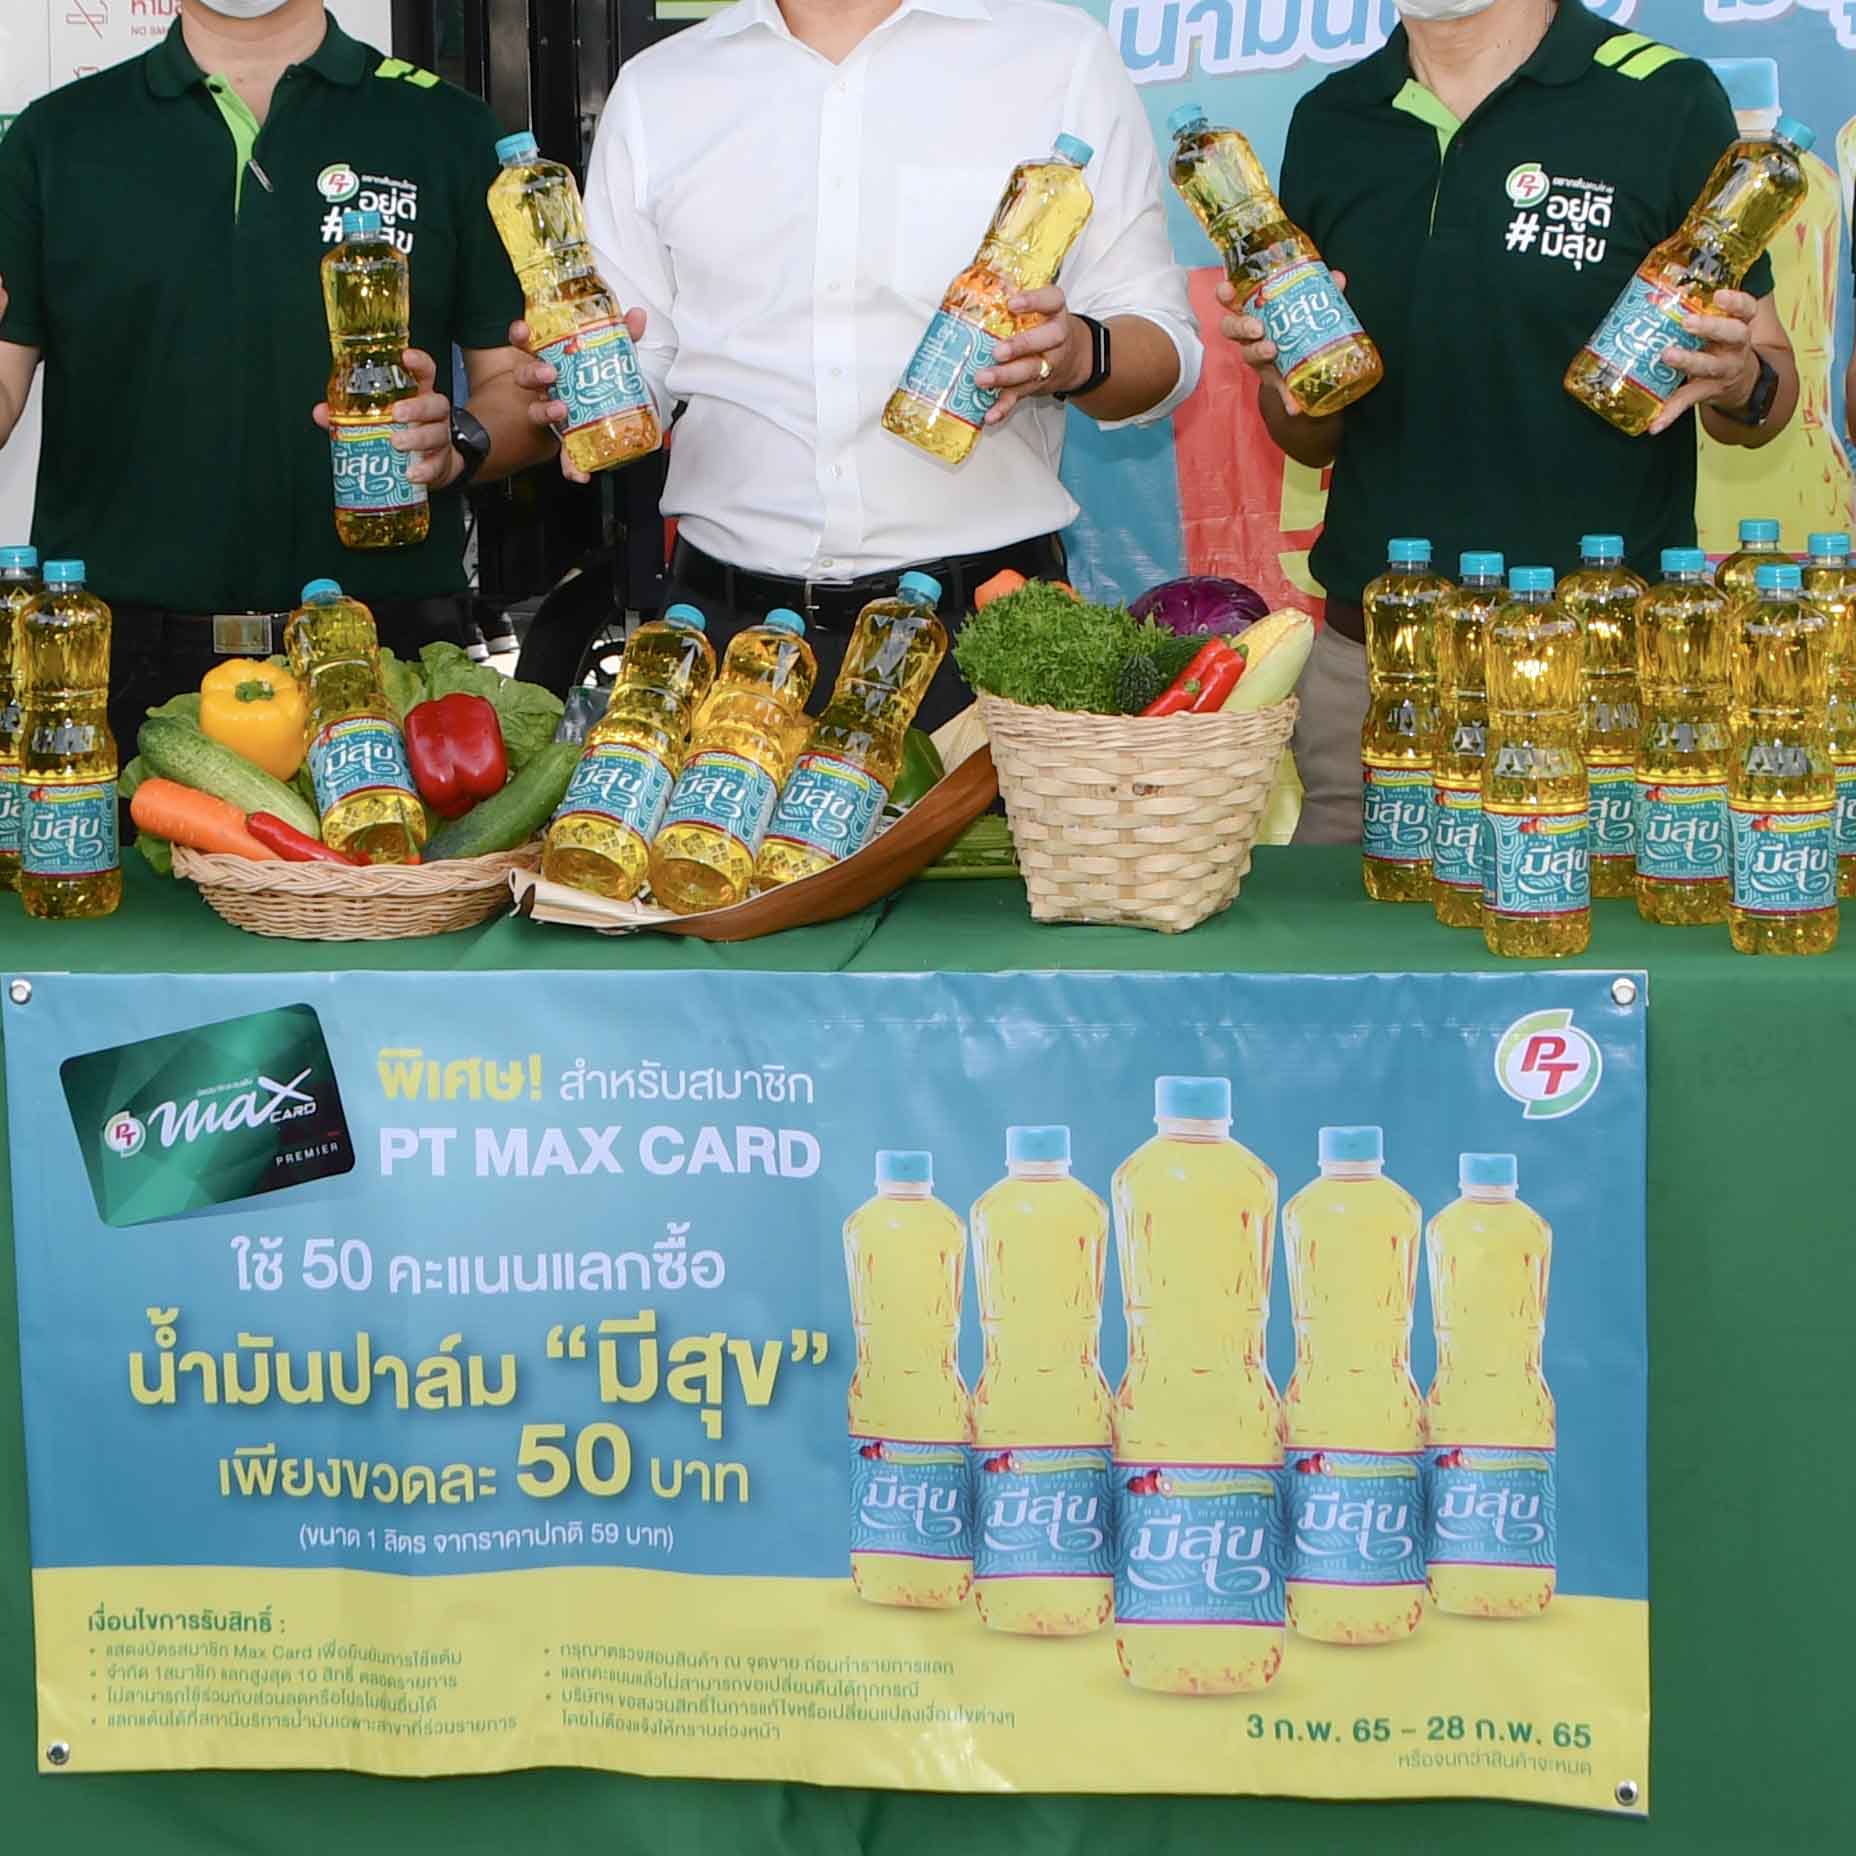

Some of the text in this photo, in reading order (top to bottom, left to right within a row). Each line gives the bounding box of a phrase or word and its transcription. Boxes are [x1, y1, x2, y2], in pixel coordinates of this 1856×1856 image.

[359, 188, 417, 226] อยู่ดี
[1546, 191, 1614, 232] อยู่ดี
[376, 1047, 816, 1105] พิเศษ! สำหรับสมาชิก
[1518, 1035, 1580, 1095] PT
[269, 1101, 318, 1124] CARD
[275, 1141, 340, 1167] PREMIER
[380, 1126, 822, 1178] PT MAX CARD
[230, 1222, 727, 1295] ใช้ 50 คะแนนแลกซื้อ
[128, 1307, 518, 1408] น้ำมันปาล์ม
[218, 1422, 750, 1505] เพียงขวดละ 50 บาท
[859, 1473, 962, 1537] มีสุข
[984, 1486, 1103, 1552] มีสุข
[1296, 1491, 1412, 1559] มีสุข
[1433, 1483, 1545, 1544] มีสุข
[299, 1520, 674, 1554] (ขนาด 1 ลิตร จากราคาปกติ 59 บาท)
[1127, 1514, 1271, 1595] มีสุข
[233, 1646, 266, 1658] Max
[272, 1646, 312, 1659] Card
[300, 1669, 317, 1683] 10
[1247, 1714, 1593, 1749] 3 ก.พ. 65 28 ก.พ. 65
